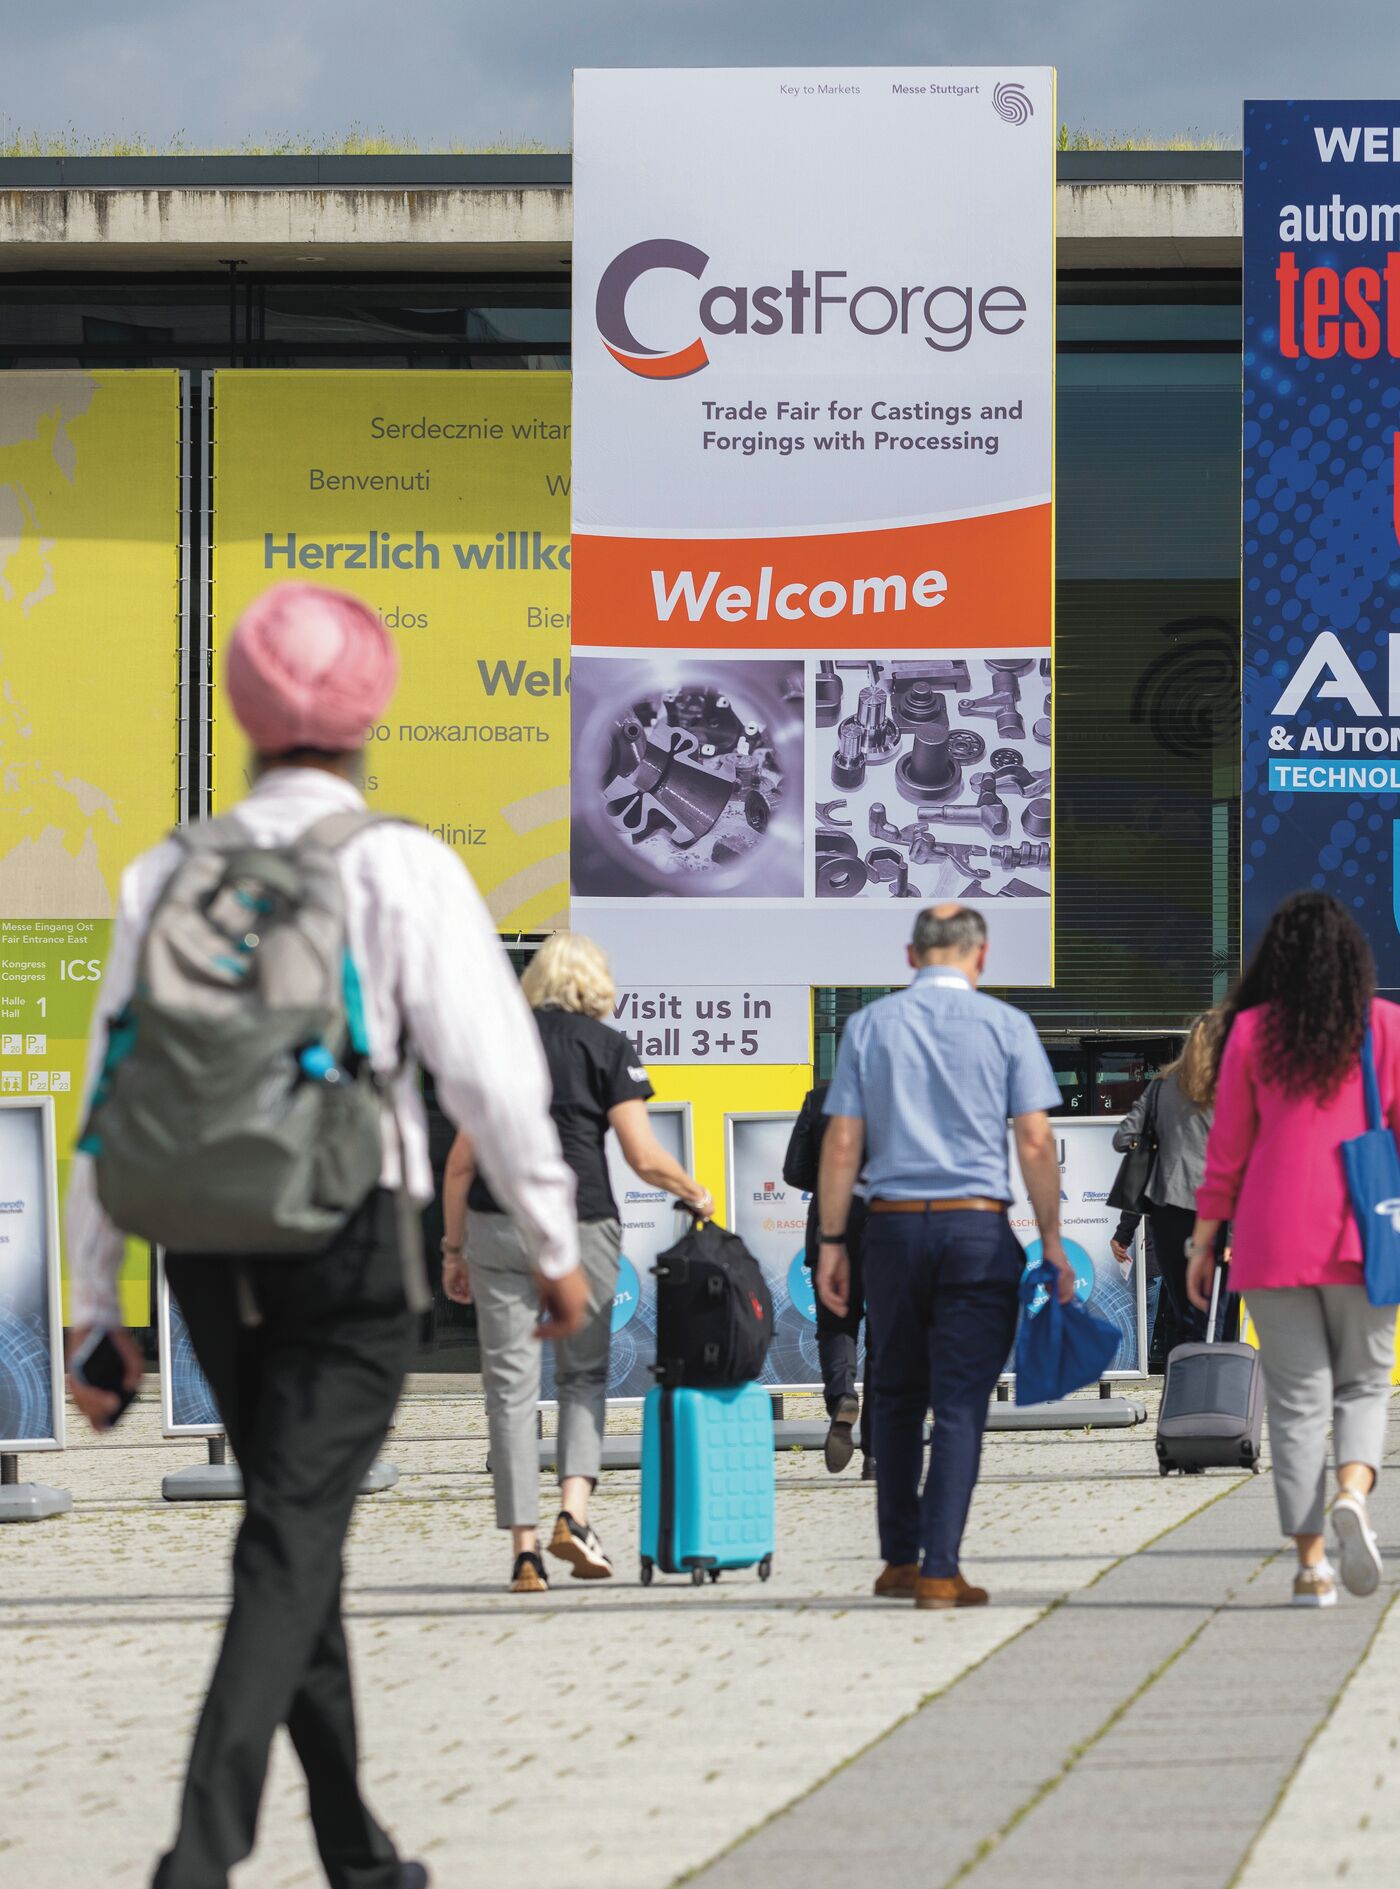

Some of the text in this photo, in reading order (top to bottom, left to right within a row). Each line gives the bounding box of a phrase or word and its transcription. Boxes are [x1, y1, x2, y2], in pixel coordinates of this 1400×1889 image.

[780, 84, 861, 97] Key to Markets
[892, 84, 980, 97] Messe Stuttgart
[595, 238, 1027, 380] CastForge
[702, 400, 1023, 425] Trade Fair for Castings and
[371, 417, 504, 440] Serdecznie
[703, 430, 1000, 455] Forgings with Processing
[309, 469, 431, 491] Benvenuti
[264, 530, 441, 570] Herzlich
[650, 566, 949, 622] Welcome
[477, 658, 571, 697] Wel
[399, 724, 550, 743] пожаловать
[1268, 725, 1295, 752] &
[1, 922, 94, 934] Messe Eingang Ost
[1, 936, 89, 944] Fair Entrance East
[1, 960, 46, 971] Kongress
[60, 959, 102, 982] ICS
[1, 972, 46, 983] Congress
[1, 997, 25, 1006] Halle
[36, 997, 47, 1018] 1
[613, 992, 772, 1019] Visit us in
[1, 1009, 20, 1018] Hall
[691, 1028, 760, 1056] 3+5
[753, 1192, 786, 1201] BEW
[621, 1221, 656, 1229] NEWEISS
[1063, 1217, 1109, 1225] SCHÖNEWEISS
